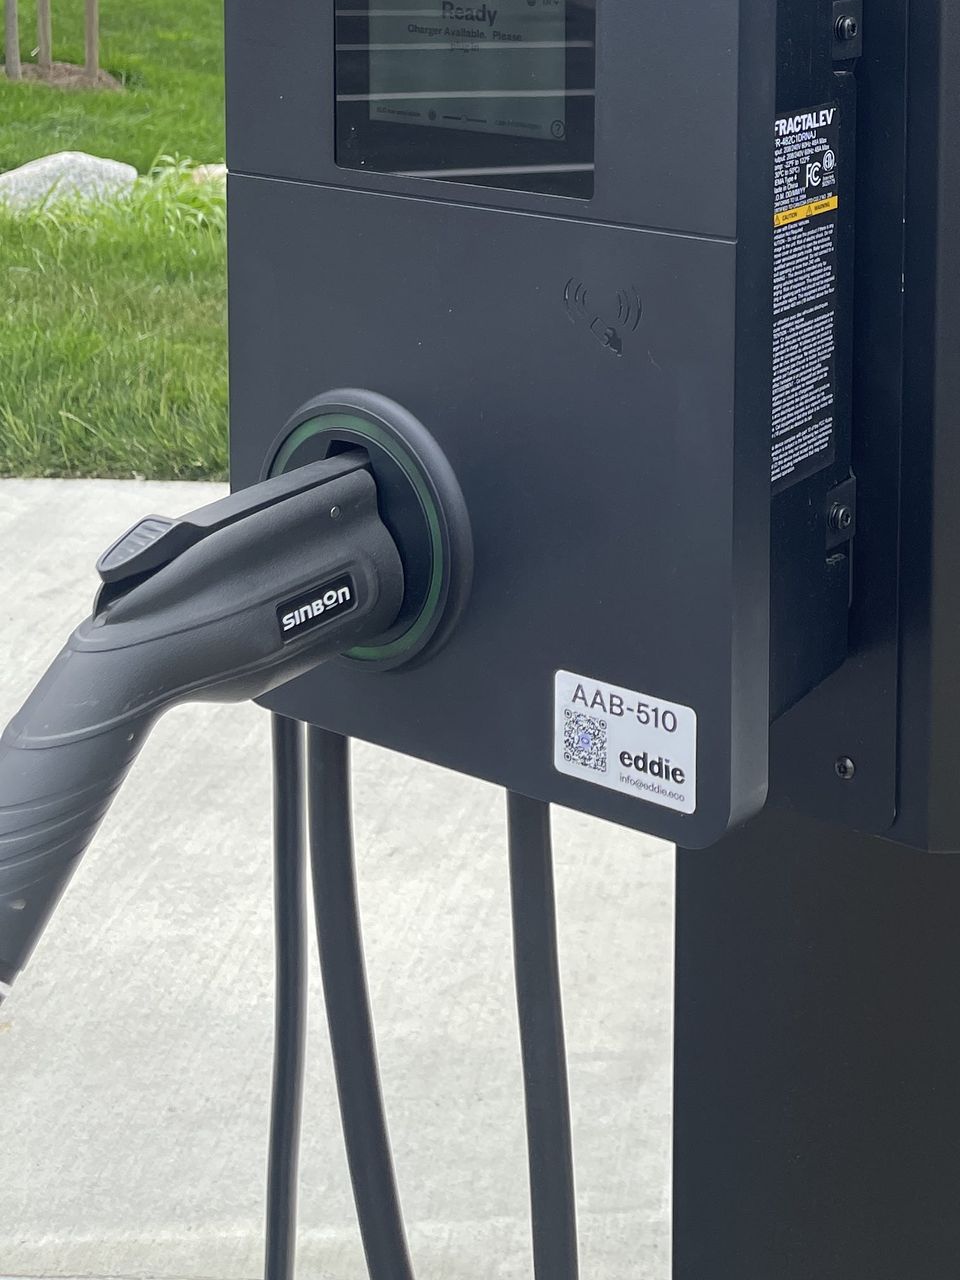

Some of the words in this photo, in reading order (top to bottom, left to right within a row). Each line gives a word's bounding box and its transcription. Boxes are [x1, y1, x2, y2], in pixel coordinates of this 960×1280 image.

[442, 0, 497, 27] Ready
[407, 24, 442, 37] Charger
[492, 31, 523, 42] Please
[571, 683, 678, 733] AAB-510
[619, 750, 686, 784] eddie
